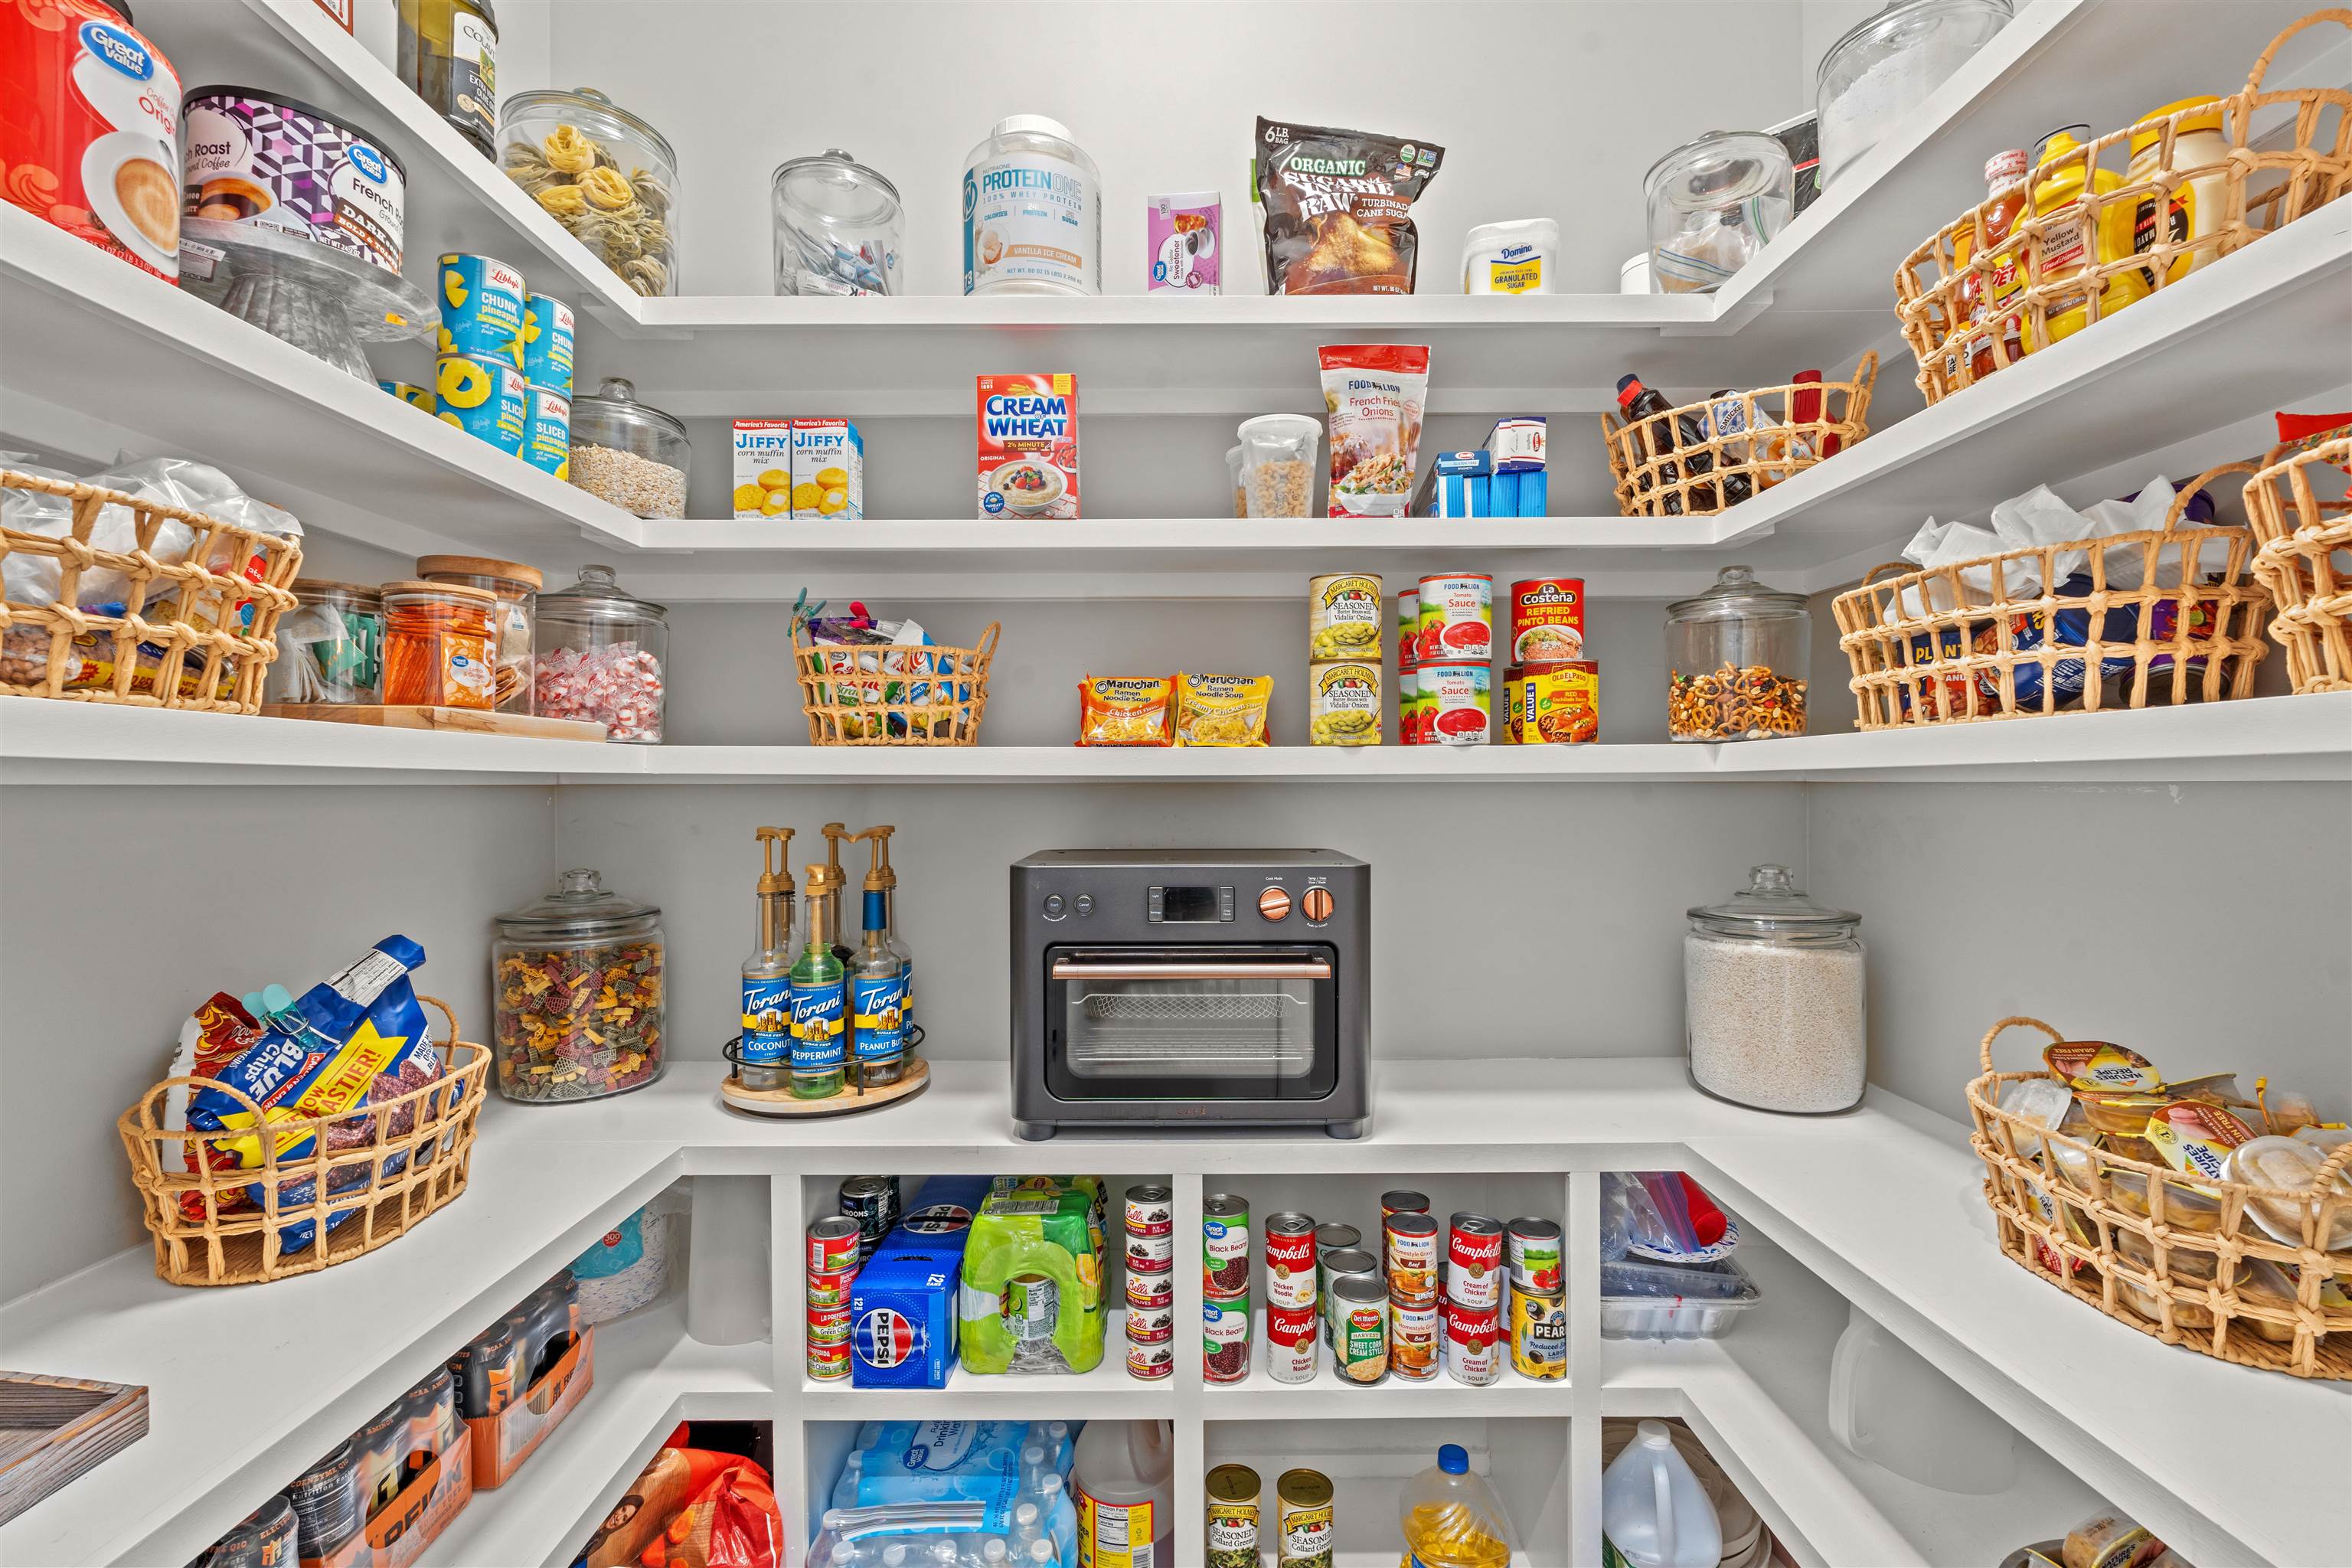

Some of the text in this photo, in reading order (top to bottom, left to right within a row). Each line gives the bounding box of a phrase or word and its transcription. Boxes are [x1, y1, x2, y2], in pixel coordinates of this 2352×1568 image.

[90, 28, 145, 67] Great
[104, 46, 142, 75] Value
[1265, 126, 1275, 142] 6
[195, 142, 231, 157] Roast
[201, 158, 230, 171] Coffee
[354, 148, 382, 174] Great
[1291, 157, 1366, 176] ORGANIC
[361, 162, 382, 179] Value
[983, 169, 1082, 201] PROTEIN ONE
[353, 178, 394, 215] French
[1044, 193, 1082, 211] PROTEIN
[1298, 193, 1356, 222] RAW
[1357, 208, 1383, 217] CANE
[984, 211, 1008, 221] CALORIES
[338, 217, 365, 237] BOLD
[342, 204, 386, 243] DARK
[2043, 227, 2074, 246] Yellow
[2041, 233, 2079, 257] Mustard
[1014, 247, 1042, 256] VANILLA
[1044, 248, 1054, 257] ICE
[1055, 252, 1076, 264] CREAM
[1501, 244, 1532, 260] Domino
[2042, 246, 2083, 271] Traditional
[490, 269, 519, 289] Libby's
[1494, 273, 1537, 284] GRANULATED
[481, 292, 518, 315] CHUNK
[482, 304, 520, 326] pineapple
[1349, 381, 1400, 393] FOOD LION
[986, 395, 1067, 416] CREAM
[1350, 395, 1380, 407] French
[544, 400, 567, 416] Libby's
[1362, 407, 1393, 416] Onions
[536, 422, 565, 440] SLICED
[988, 418, 1067, 438] WHEAT
[735, 433, 787, 449] JIFFY
[794, 432, 844, 448] JIFFY
[757, 449, 785, 457] muffin
[1330, 580, 1377, 595] MARGARET HOLMES
[1543, 584, 1553, 593] La
[1449, 599, 1476, 608] Sauce
[1524, 592, 1573, 604] Costeña
[1333, 602, 1374, 611] SEASONED
[1527, 606, 1570, 616] REFRIED
[1517, 616, 1579, 626] PINTO BEANS
[1200, 674, 1256, 685] Maruchan
[1326, 668, 1374, 682] MARGARET HOLMES
[1107, 679, 1160, 689] Maruchan
[1328, 690, 1371, 698] SEASONED
[1442, 687, 1469, 695] Sauce
[1109, 708, 1142, 717] Chicken
[1184, 697, 1246, 716] Creamy Chicken
[1527, 693, 1535, 721] VALUE
[792, 991, 841, 1024] Torani
[749, 1040, 790, 1050] COCONUT
[860, 1041, 890, 1050] PEANUT
[793, 1047, 841, 1060] PEPPERMINT
[245, 1044, 280, 1083] Chips
[250, 1038, 303, 1102] BLUE
[2213, 1110, 2232, 1129] FREE
[1206, 1225, 1223, 1233] Great
[1230, 1241, 1246, 1251] Beans
[1393, 1247, 1419, 1257] Homestyle
[1128, 1279, 1148, 1295] Bell's
[1273, 1282, 1294, 1290] Chicken
[1463, 1280, 1481, 1289] Cream
[1274, 1289, 1293, 1297] Noodle
[1464, 1287, 1487, 1296] Chicken
[1128, 1315, 1148, 1329] Bell's
[1398, 1323, 1424, 1332] Homestyle
[1205, 1326, 1244, 1336] Black Beans
[877, 1312, 890, 1364] PEPSI
[1350, 1340, 1382, 1349] SWEET CORN
[1349, 1347, 1383, 1357] CREAM STYLE
[1530, 1341, 1558, 1350] Reduced
[1127, 1349, 1147, 1364] Bell's
[1292, 1357, 1312, 1365] Chicken
[1462, 1357, 1481, 1366] Cream
[1292, 1363, 1311, 1372] Noodle
[1464, 1364, 1487, 1373] Chicken
[907, 1449, 920, 1467] Great
[290, 1465, 338, 1488] COENZYME
[292, 1482, 333, 1499] Nutrition
[1211, 1507, 1256, 1516] MARGARET HOLMES
[1292, 1513, 1317, 1525] MARGARET
[1212, 1527, 1254, 1540] SEASONED
[1212, 1536, 1254, 1547] Collard Greens
[1292, 1543, 1315, 1552] Collard
